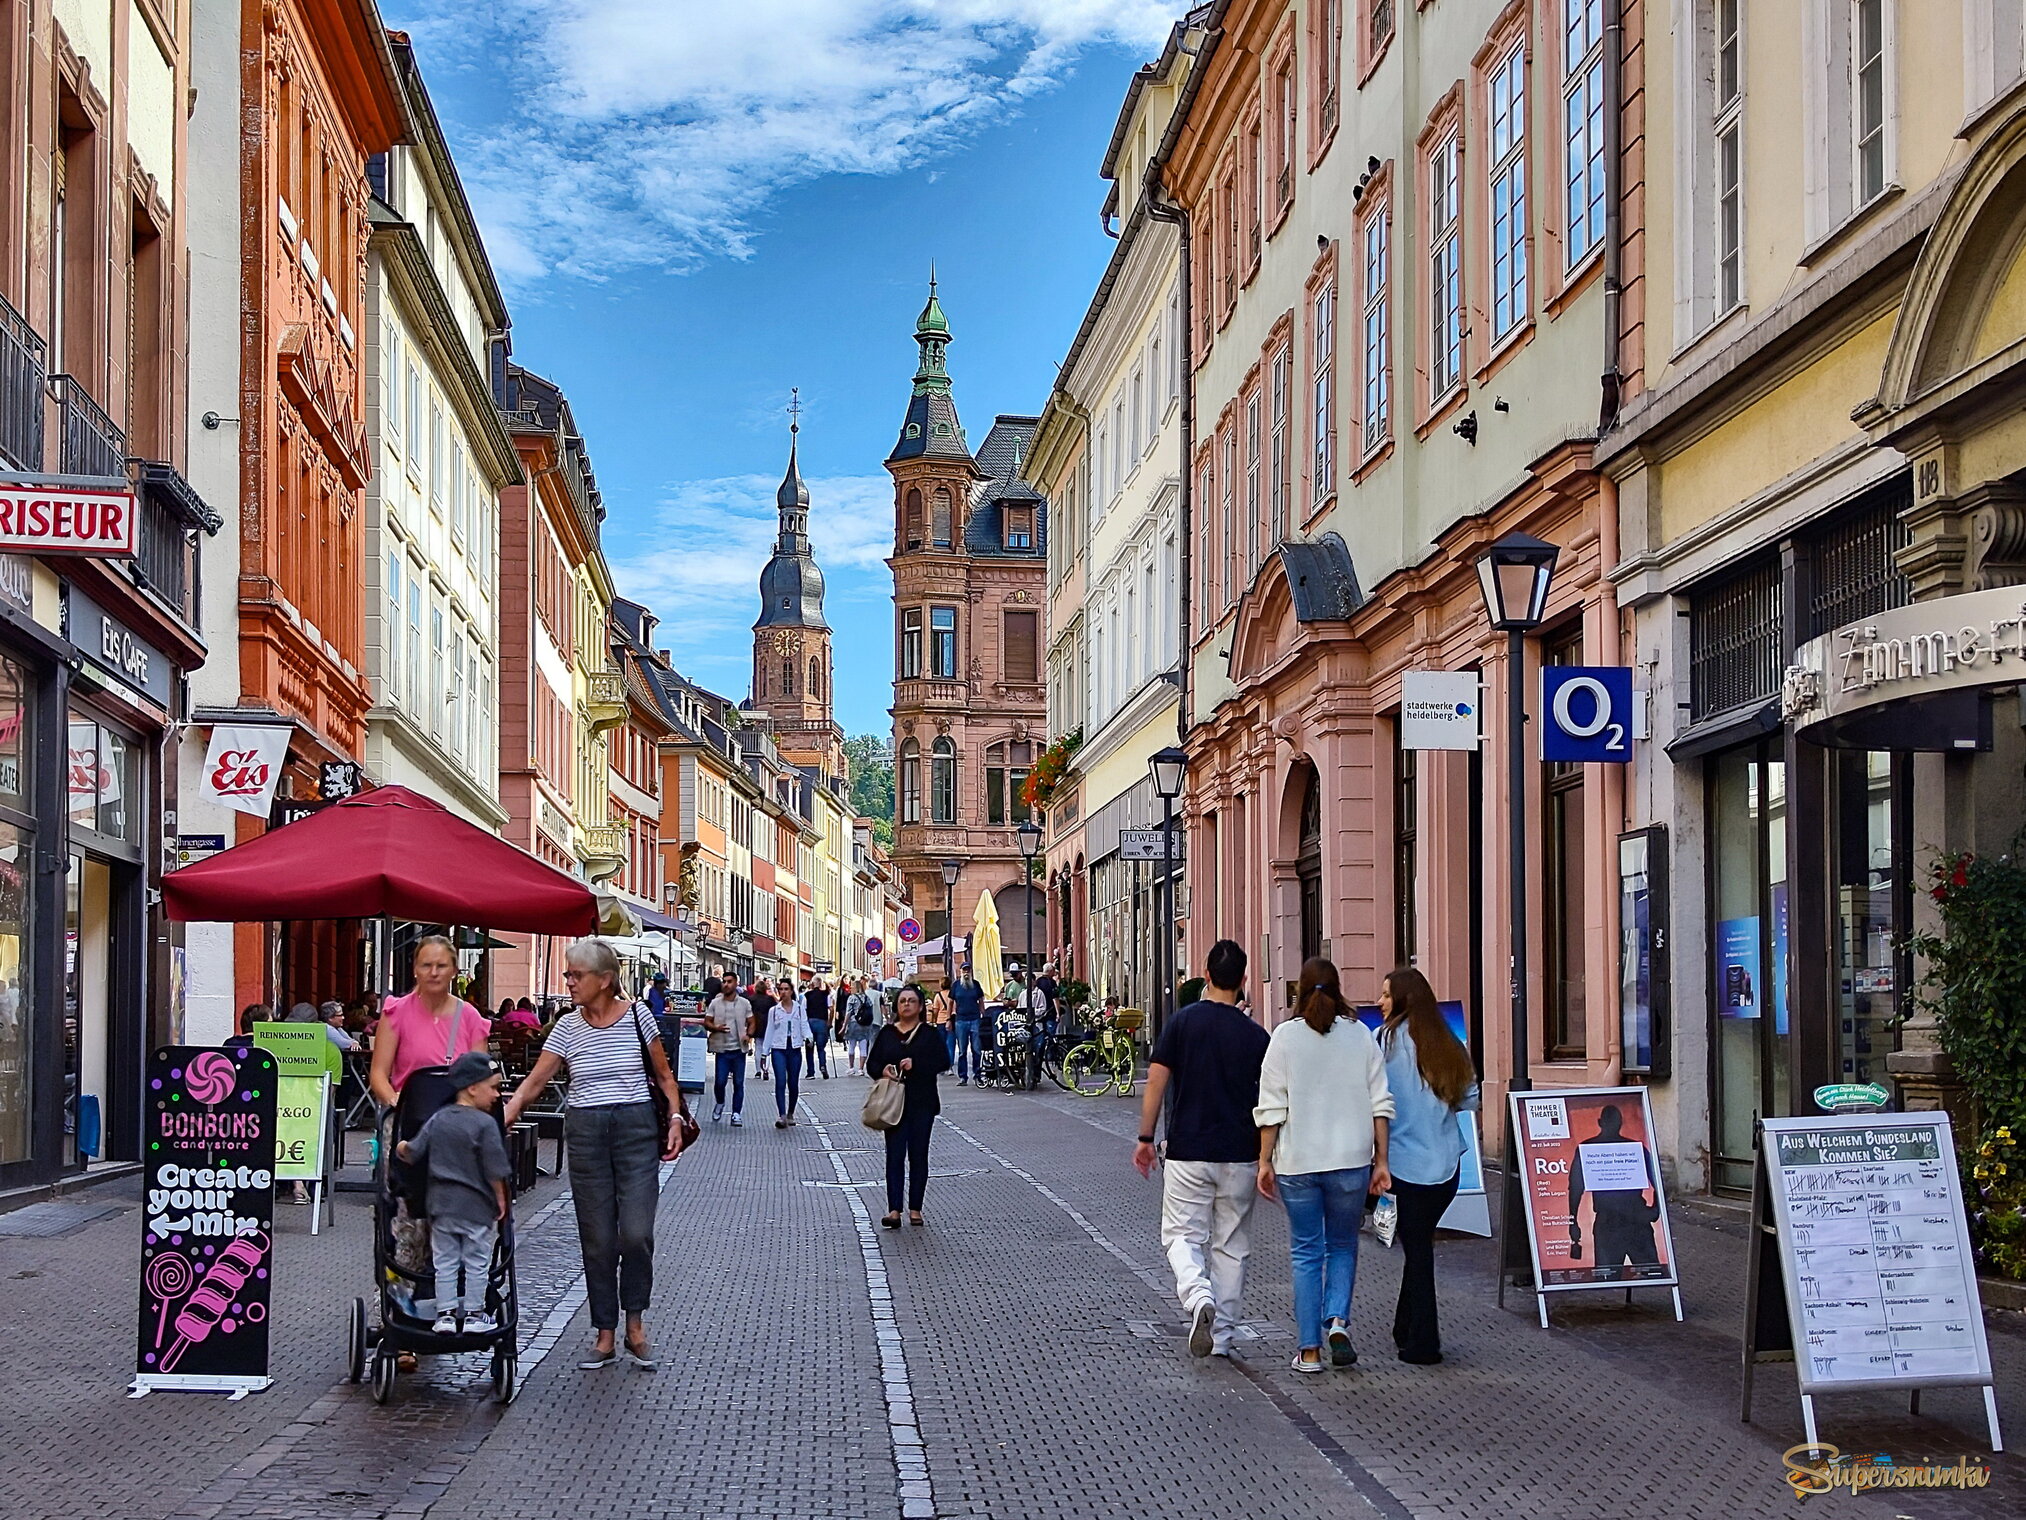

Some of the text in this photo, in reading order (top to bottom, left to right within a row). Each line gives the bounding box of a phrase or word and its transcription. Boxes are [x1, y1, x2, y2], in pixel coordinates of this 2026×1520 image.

[1406, 701, 1453, 710] stadtwerke
[1406, 711, 1453, 721] heidelberg
[211, 749, 269, 791] Eis
[259, 1031, 315, 1041] REINKOMMEN
[161, 1112, 260, 1138] BONBONS
[173, 1140, 249, 1150] candystore
[157, 1163, 271, 1189] Create
[1535, 1157, 1569, 1174] Rot
[148, 1189, 234, 1215] your
[192, 1210, 259, 1236] Mix
